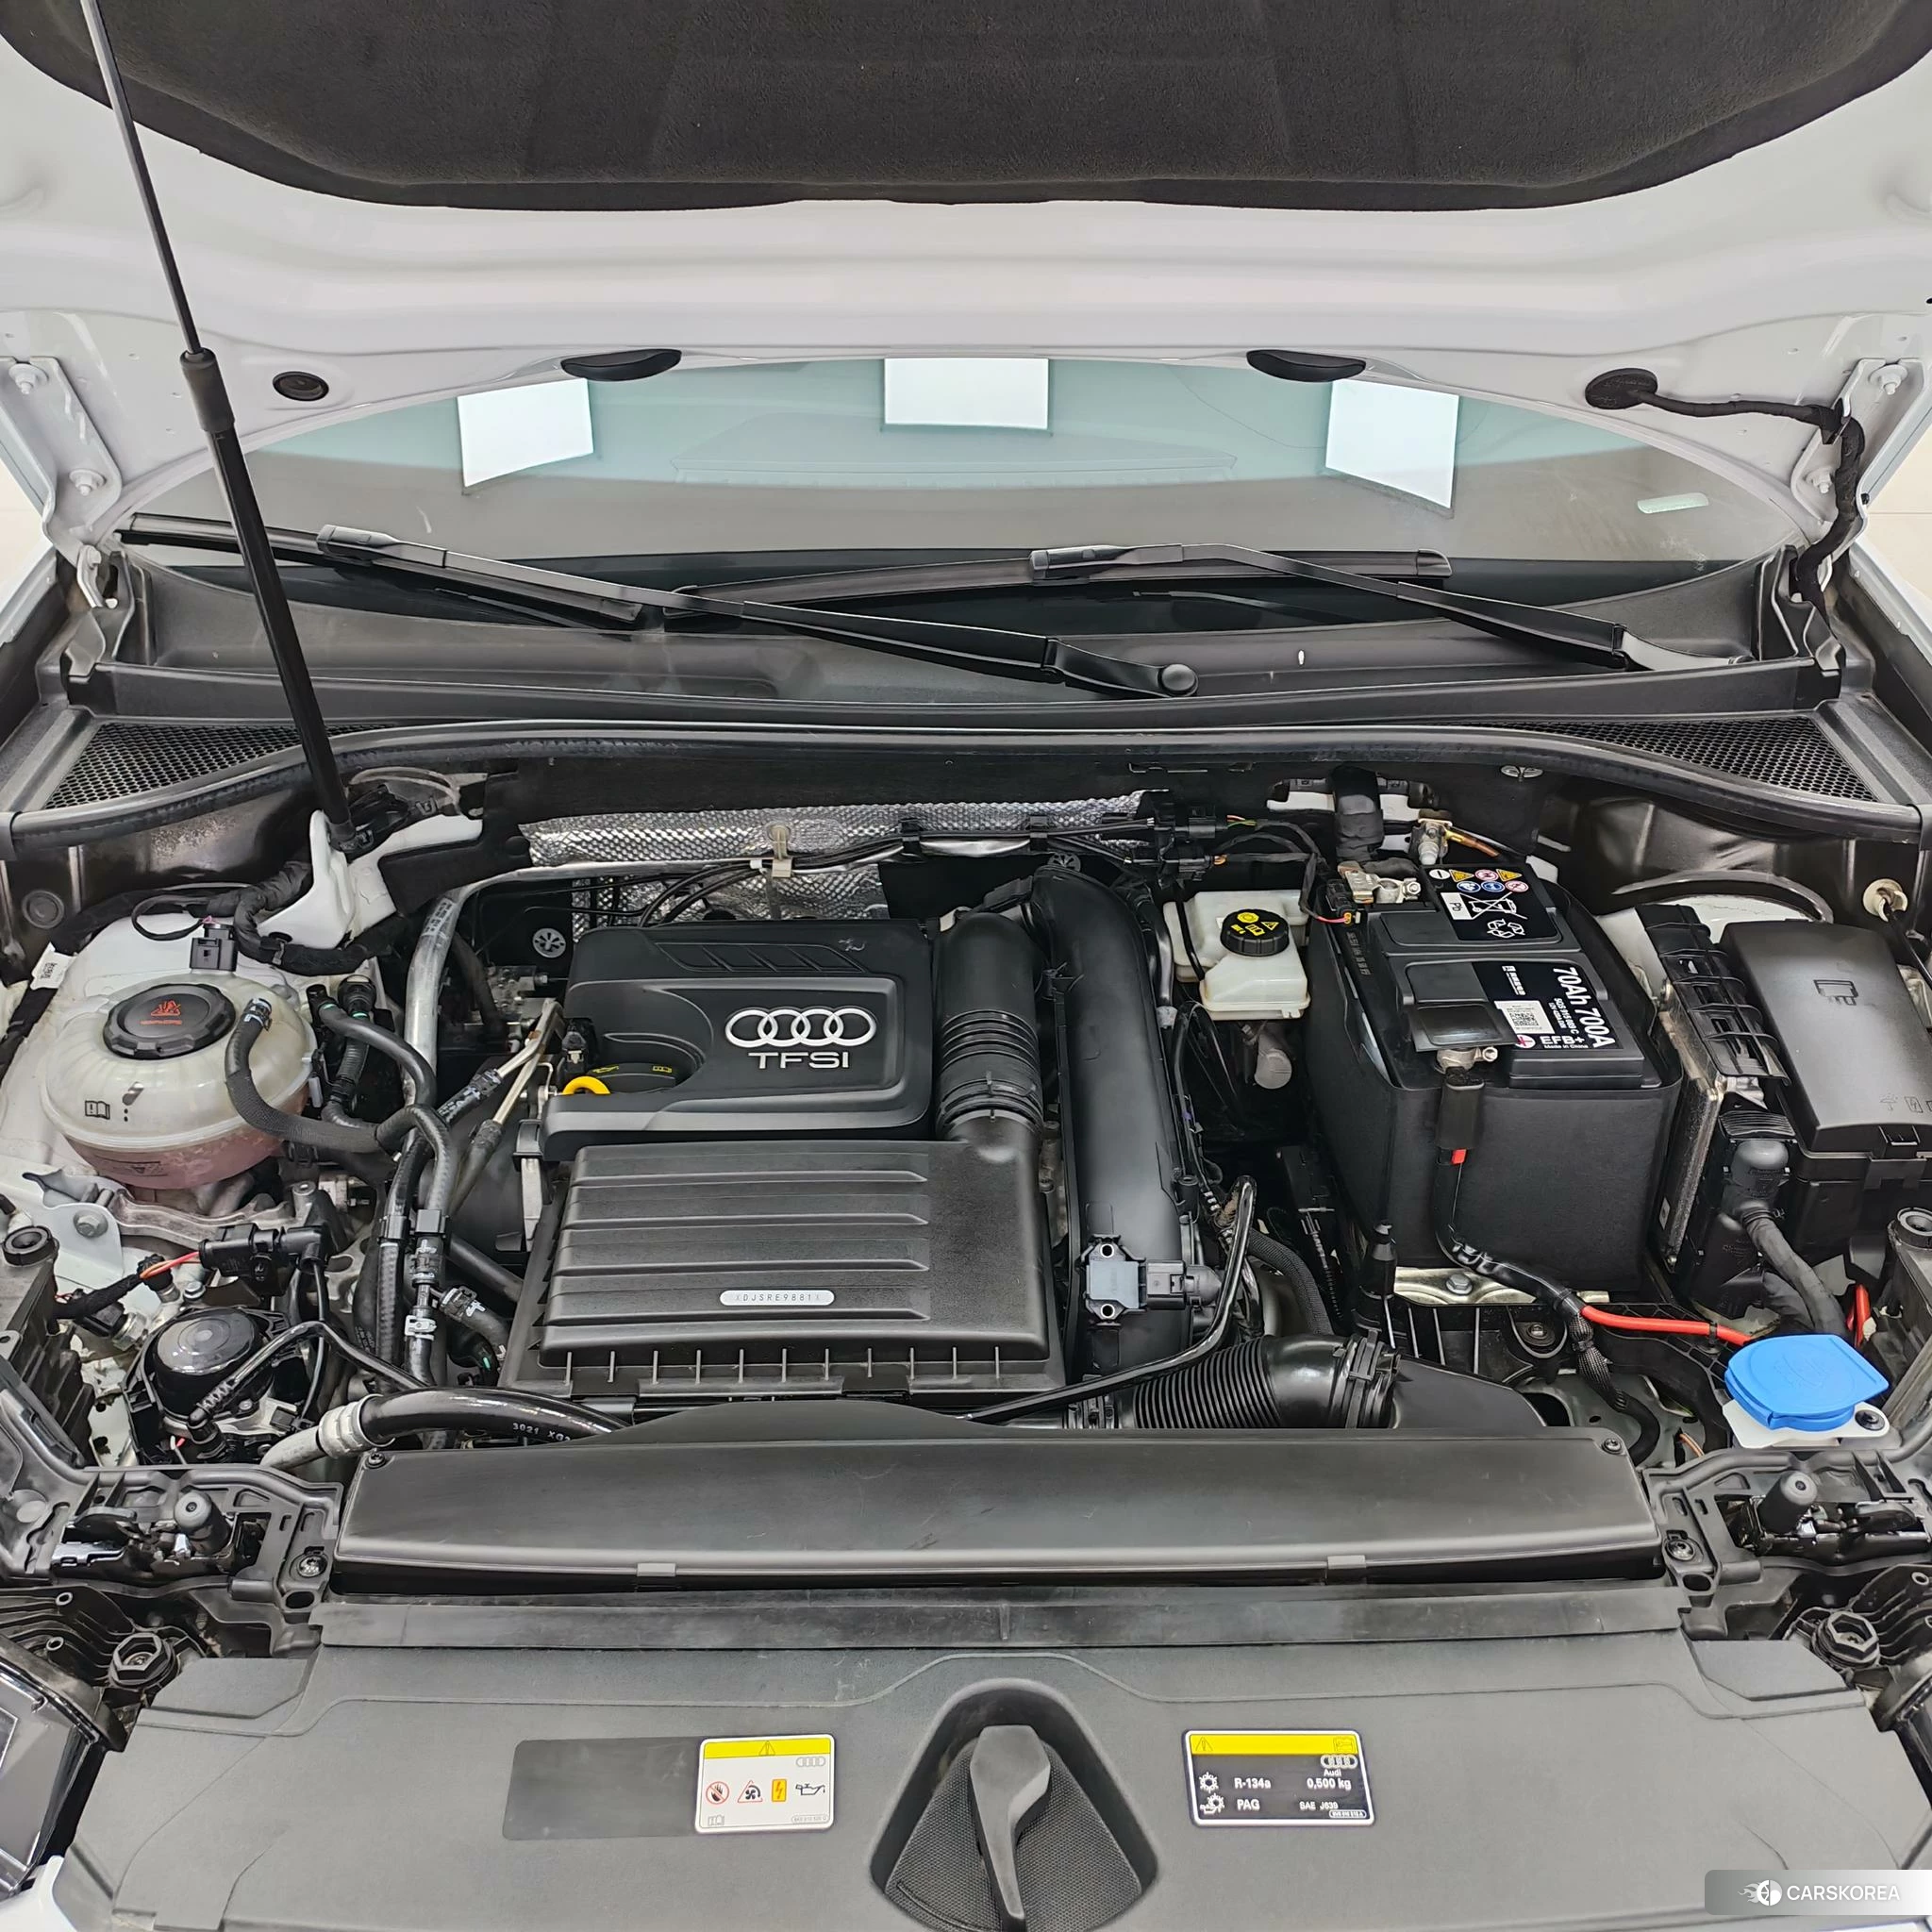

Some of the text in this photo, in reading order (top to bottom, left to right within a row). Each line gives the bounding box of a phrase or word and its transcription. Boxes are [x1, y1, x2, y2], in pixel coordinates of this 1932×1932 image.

[1449, 901, 1462, 912] Pb
[1553, 967, 1616, 1048] 70Ah 700A
[1540, 1036, 1585, 1044] EFB+
[748, 1052, 848, 1069] TFSI
[512, 1423, 539, 1434] 3021
[1324, 1768, 1341, 1777] Audi
[1234, 1777, 1352, 1790] R-134a 0,500 kg
[1237, 1799, 1260, 1810] PAG
[1299, 1800, 1316, 1810] SAE
